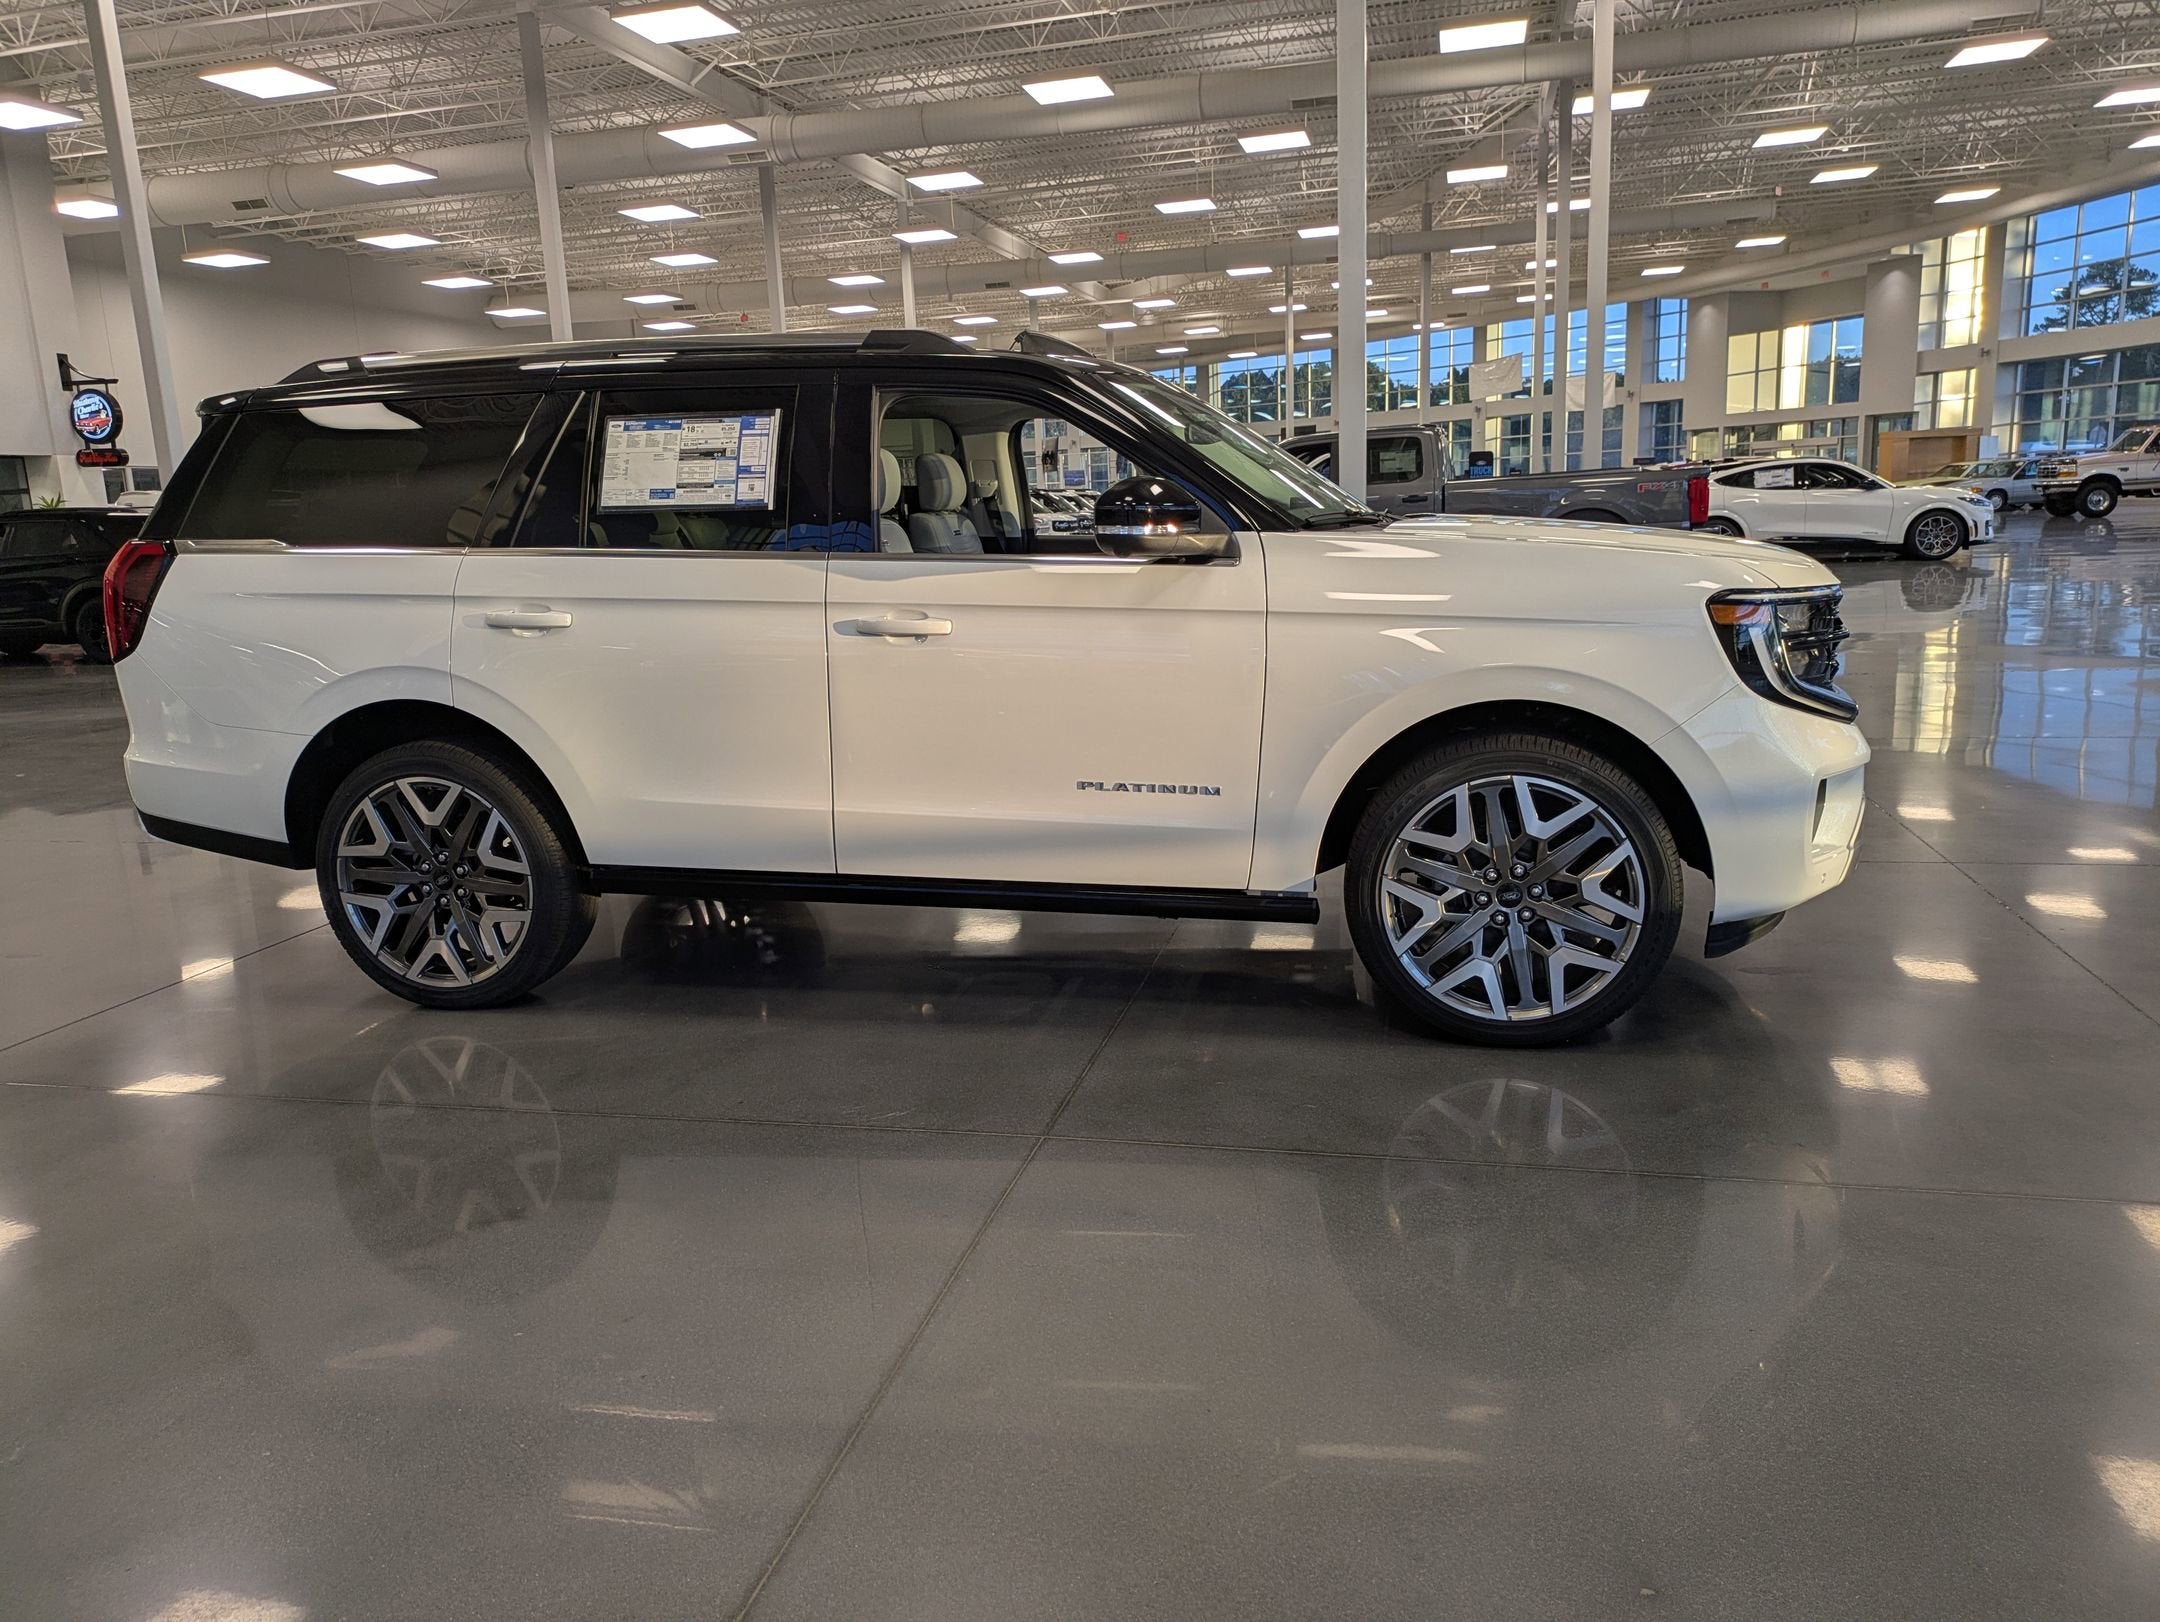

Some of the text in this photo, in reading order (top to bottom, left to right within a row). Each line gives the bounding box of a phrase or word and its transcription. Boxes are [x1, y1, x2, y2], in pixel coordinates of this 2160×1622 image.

[1470, 466, 1492, 476] TRUCK
[1637, 481, 1677, 493] FX4
[1076, 781, 1221, 796] PLATINUM
